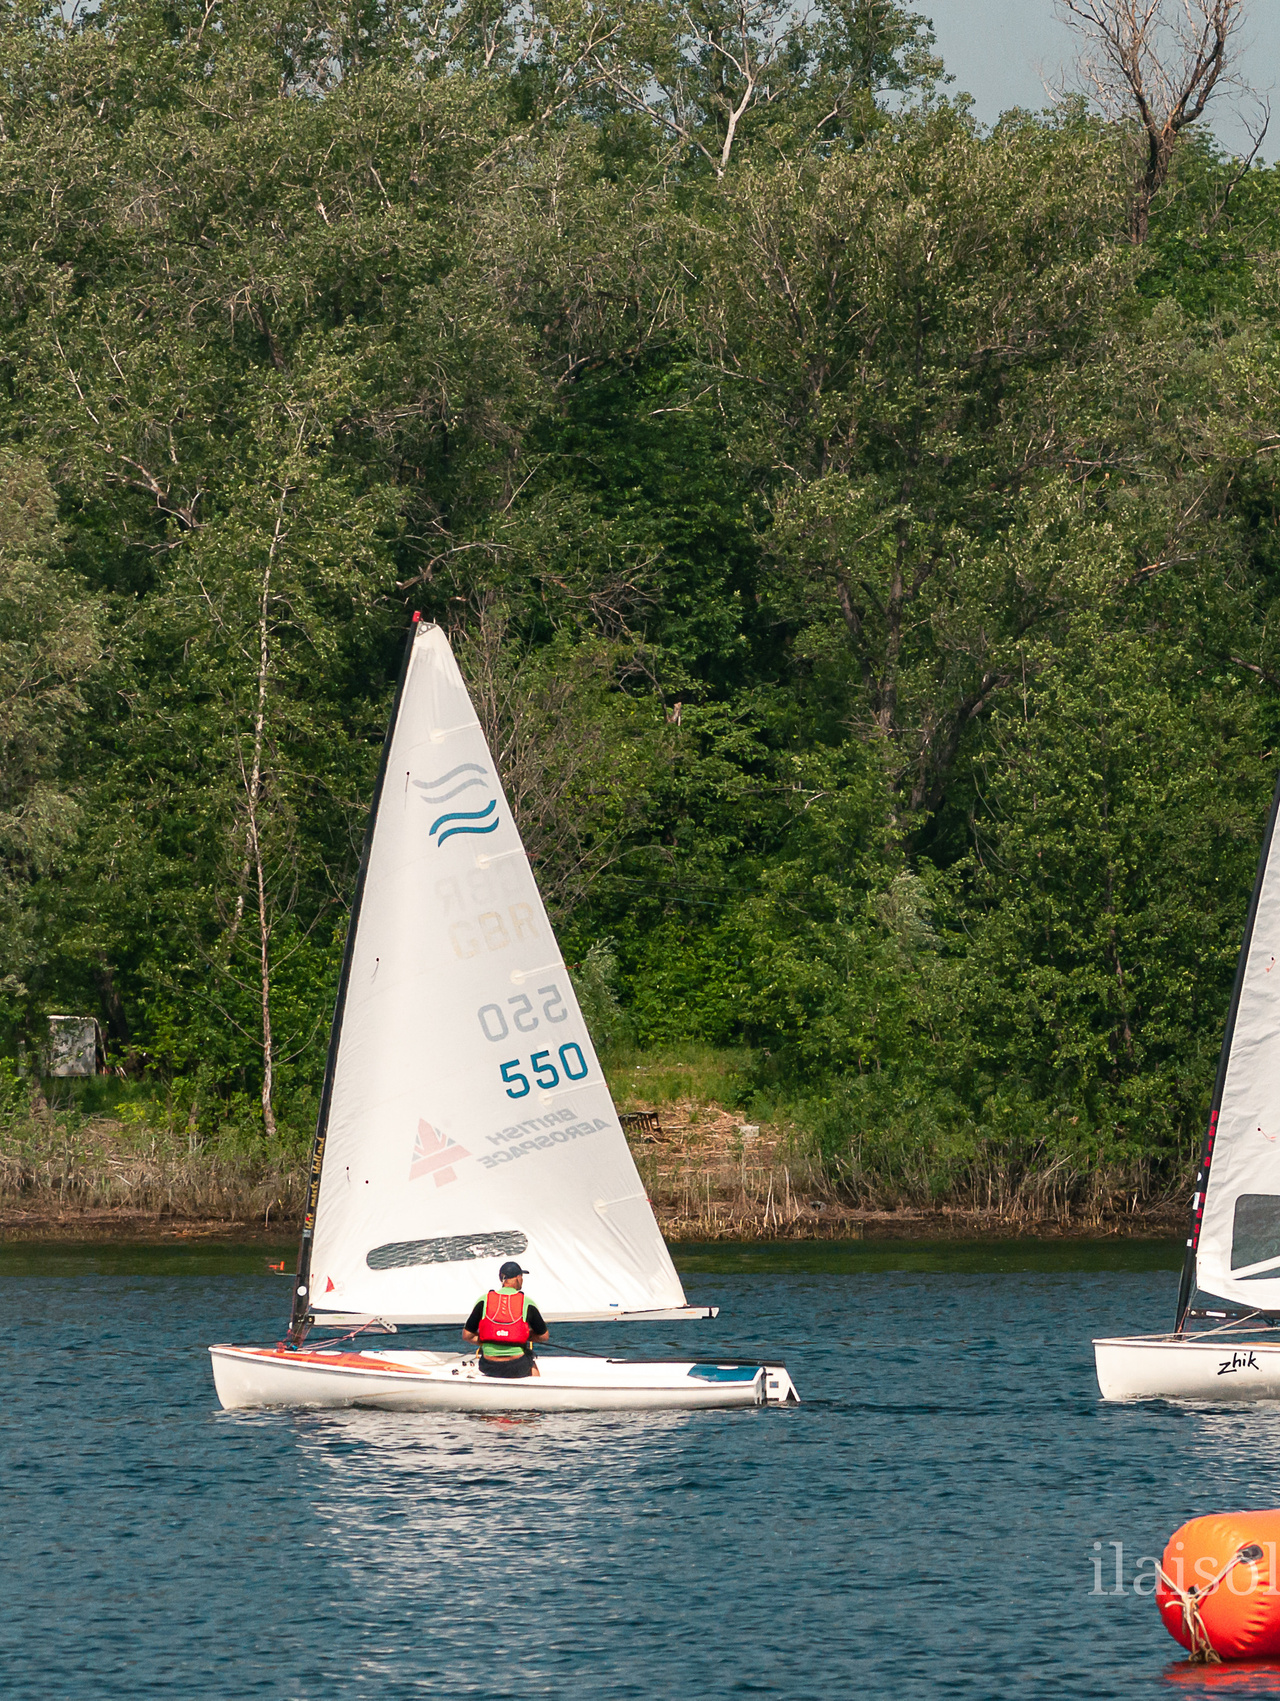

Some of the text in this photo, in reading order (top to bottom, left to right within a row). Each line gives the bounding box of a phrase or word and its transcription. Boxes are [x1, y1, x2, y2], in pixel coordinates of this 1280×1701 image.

[500, 1042, 589, 1099] 550
[312, 1136, 326, 1175] Holland
[1217, 1351, 1260, 1375] zhik
